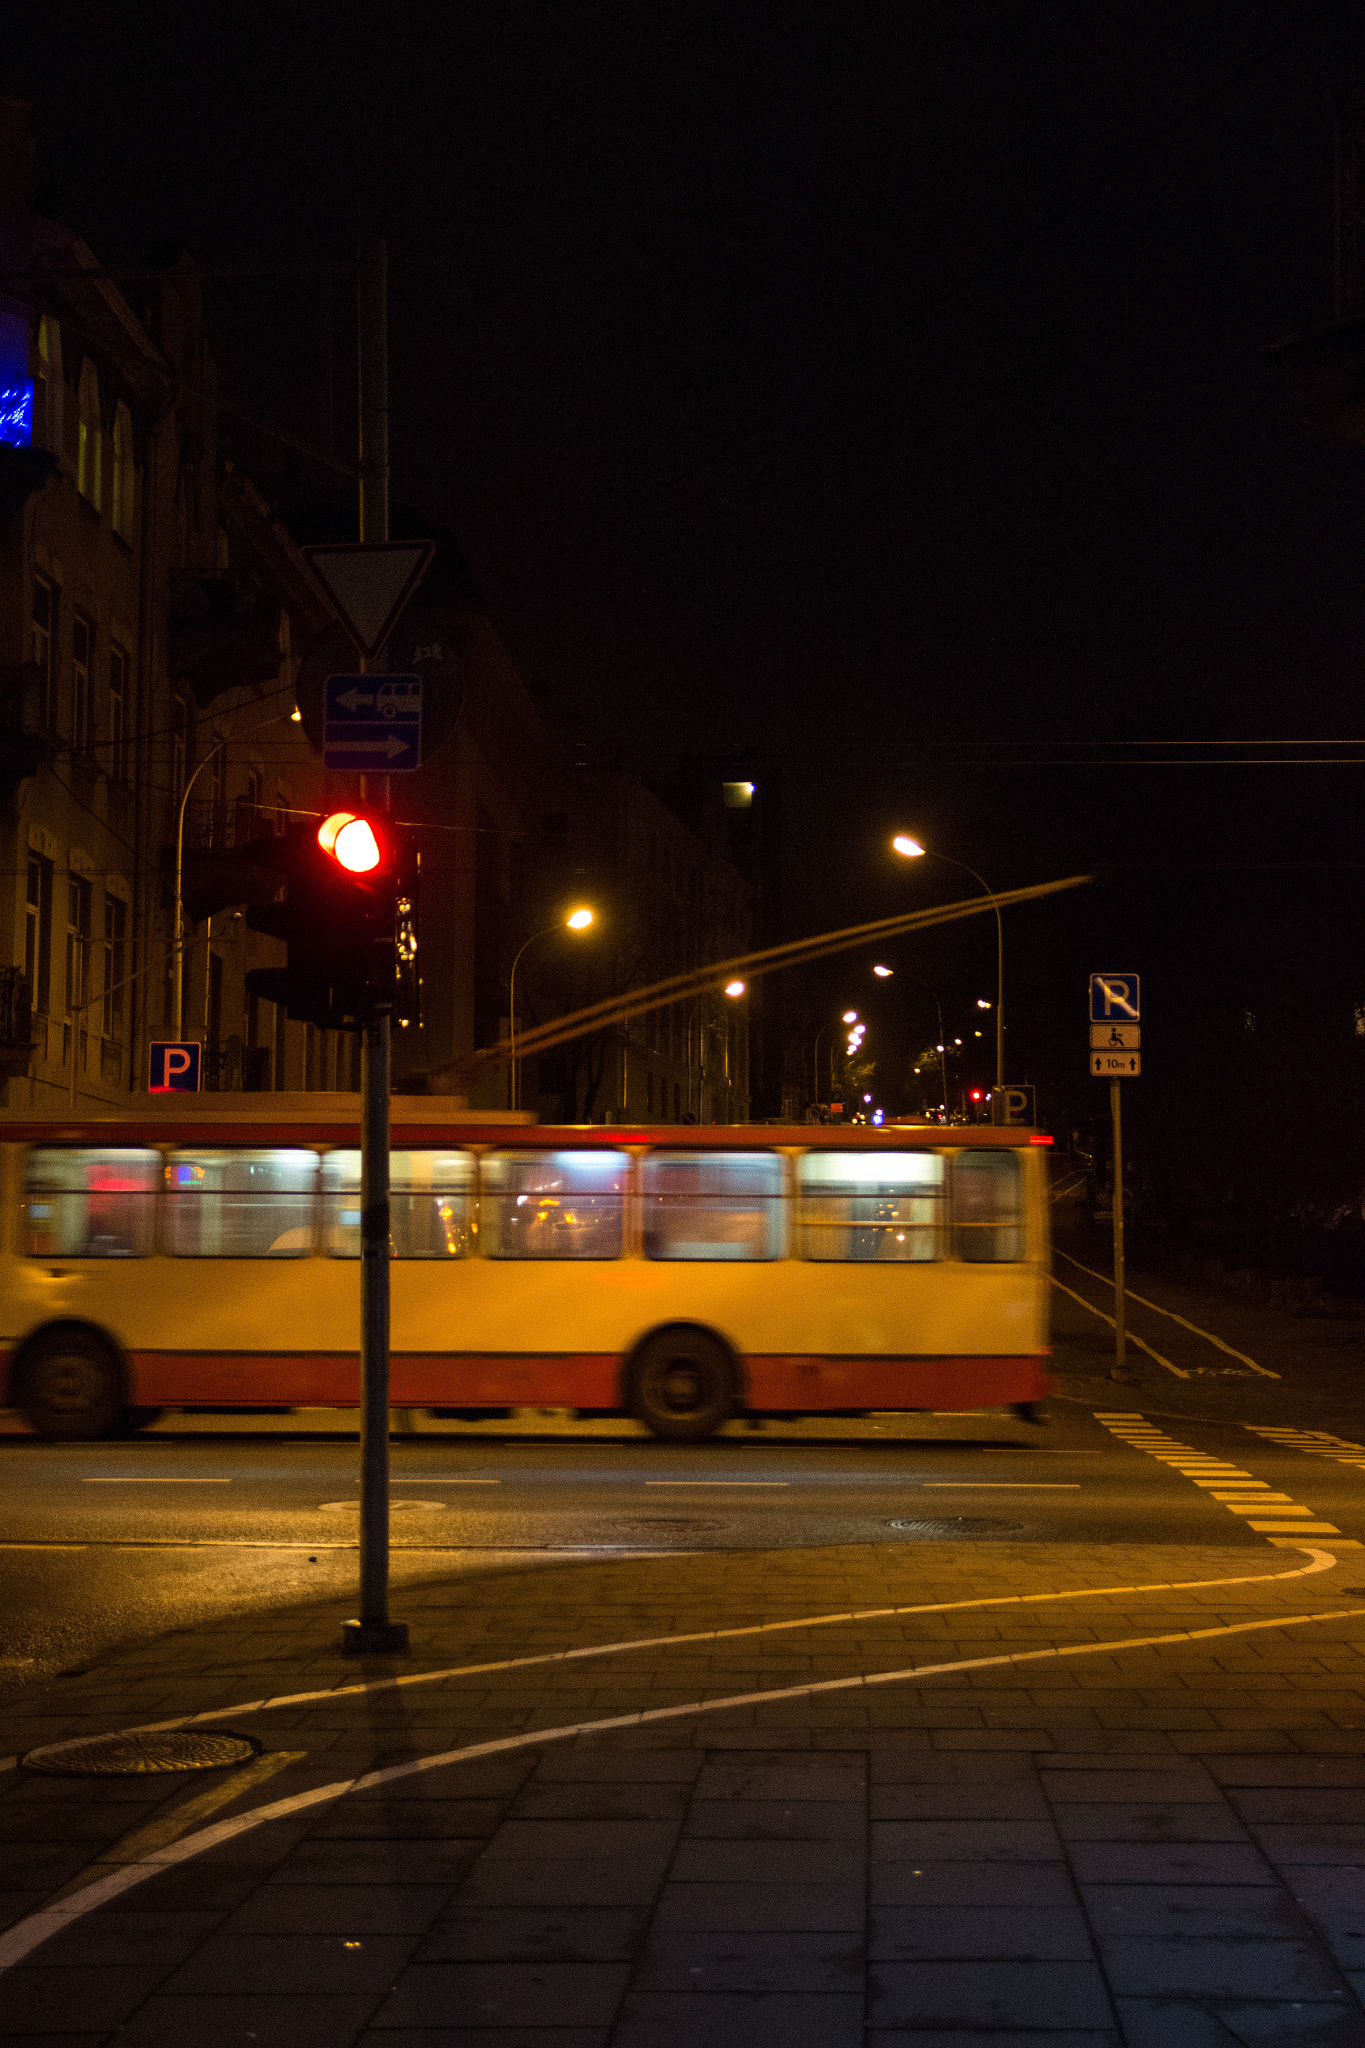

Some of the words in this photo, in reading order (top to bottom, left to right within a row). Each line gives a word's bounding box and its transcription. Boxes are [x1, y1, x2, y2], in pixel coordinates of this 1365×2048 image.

[1104, 980, 1130, 1016] P
[164, 1048, 191, 1087] P
[1107, 1059, 1125, 1069] 10m
[1005, 1090, 1027, 1124] P
